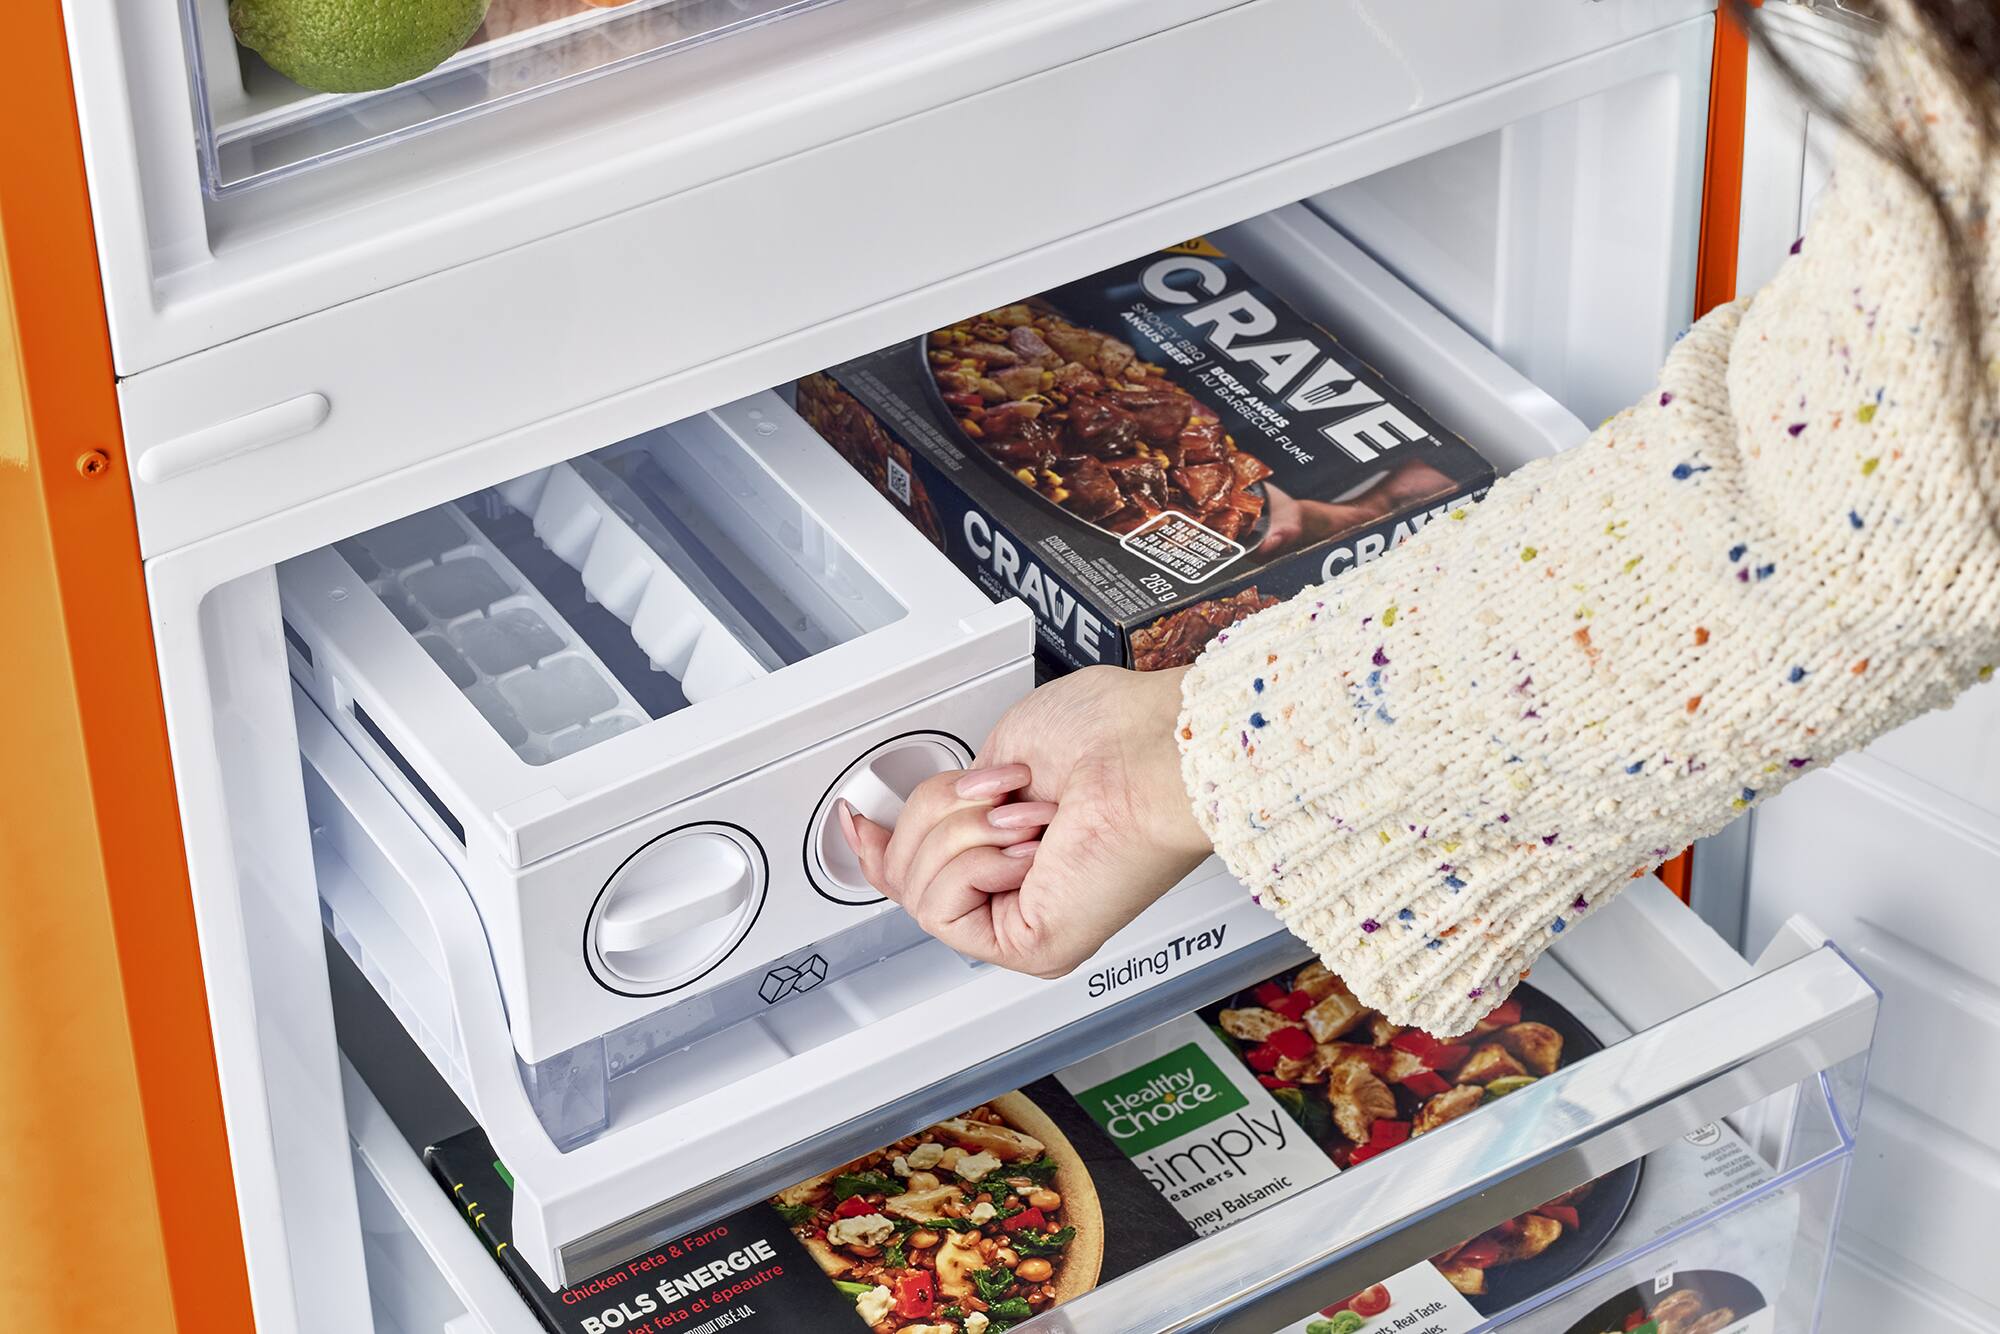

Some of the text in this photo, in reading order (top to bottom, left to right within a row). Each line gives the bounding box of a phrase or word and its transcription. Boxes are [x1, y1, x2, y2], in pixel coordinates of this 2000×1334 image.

[1120, 311, 1194, 366] ANGUS BEEF
[1132, 302, 1206, 361] SMOKEY BBQ
[1141, 256, 1430, 463] CRAVE
[1198, 373, 1314, 465] AU BARBECUE FUMÉ
[1244, 395, 1290, 428] ANGUS
[1321, 493, 1473, 583] CRA
[963, 510, 1102, 662] CRAVE
[1045, 535, 1071, 554] COOK
[1064, 547, 1107, 587] THOROUGHLY
[1104, 585, 1125, 602] BIEN
[1116, 597, 1143, 615] CUIRE
[1140, 573, 1178, 602] 283 g
[1102, 1067, 1195, 1116] Healthy
[1107, 1084, 1217, 1139] Choice
[1141, 1108, 1287, 1193] simply
[1170, 1169, 1234, 1202] eamers
[1222, 1176, 1293, 1213] Balsamic
[562, 1225, 729, 1306] Chicken Feta & Farro
[580, 1239, 777, 1334] BOLS ÉNERGIE
[654, 1309, 689, 1329] feta
[691, 1298, 711, 1313] et
[711, 1264, 785, 1306] épeautre
[714, 1313, 734, 1329] DES
[1392, 1312, 1419, 1330] Real
[1414, 1301, 1447, 1319] Taste.
